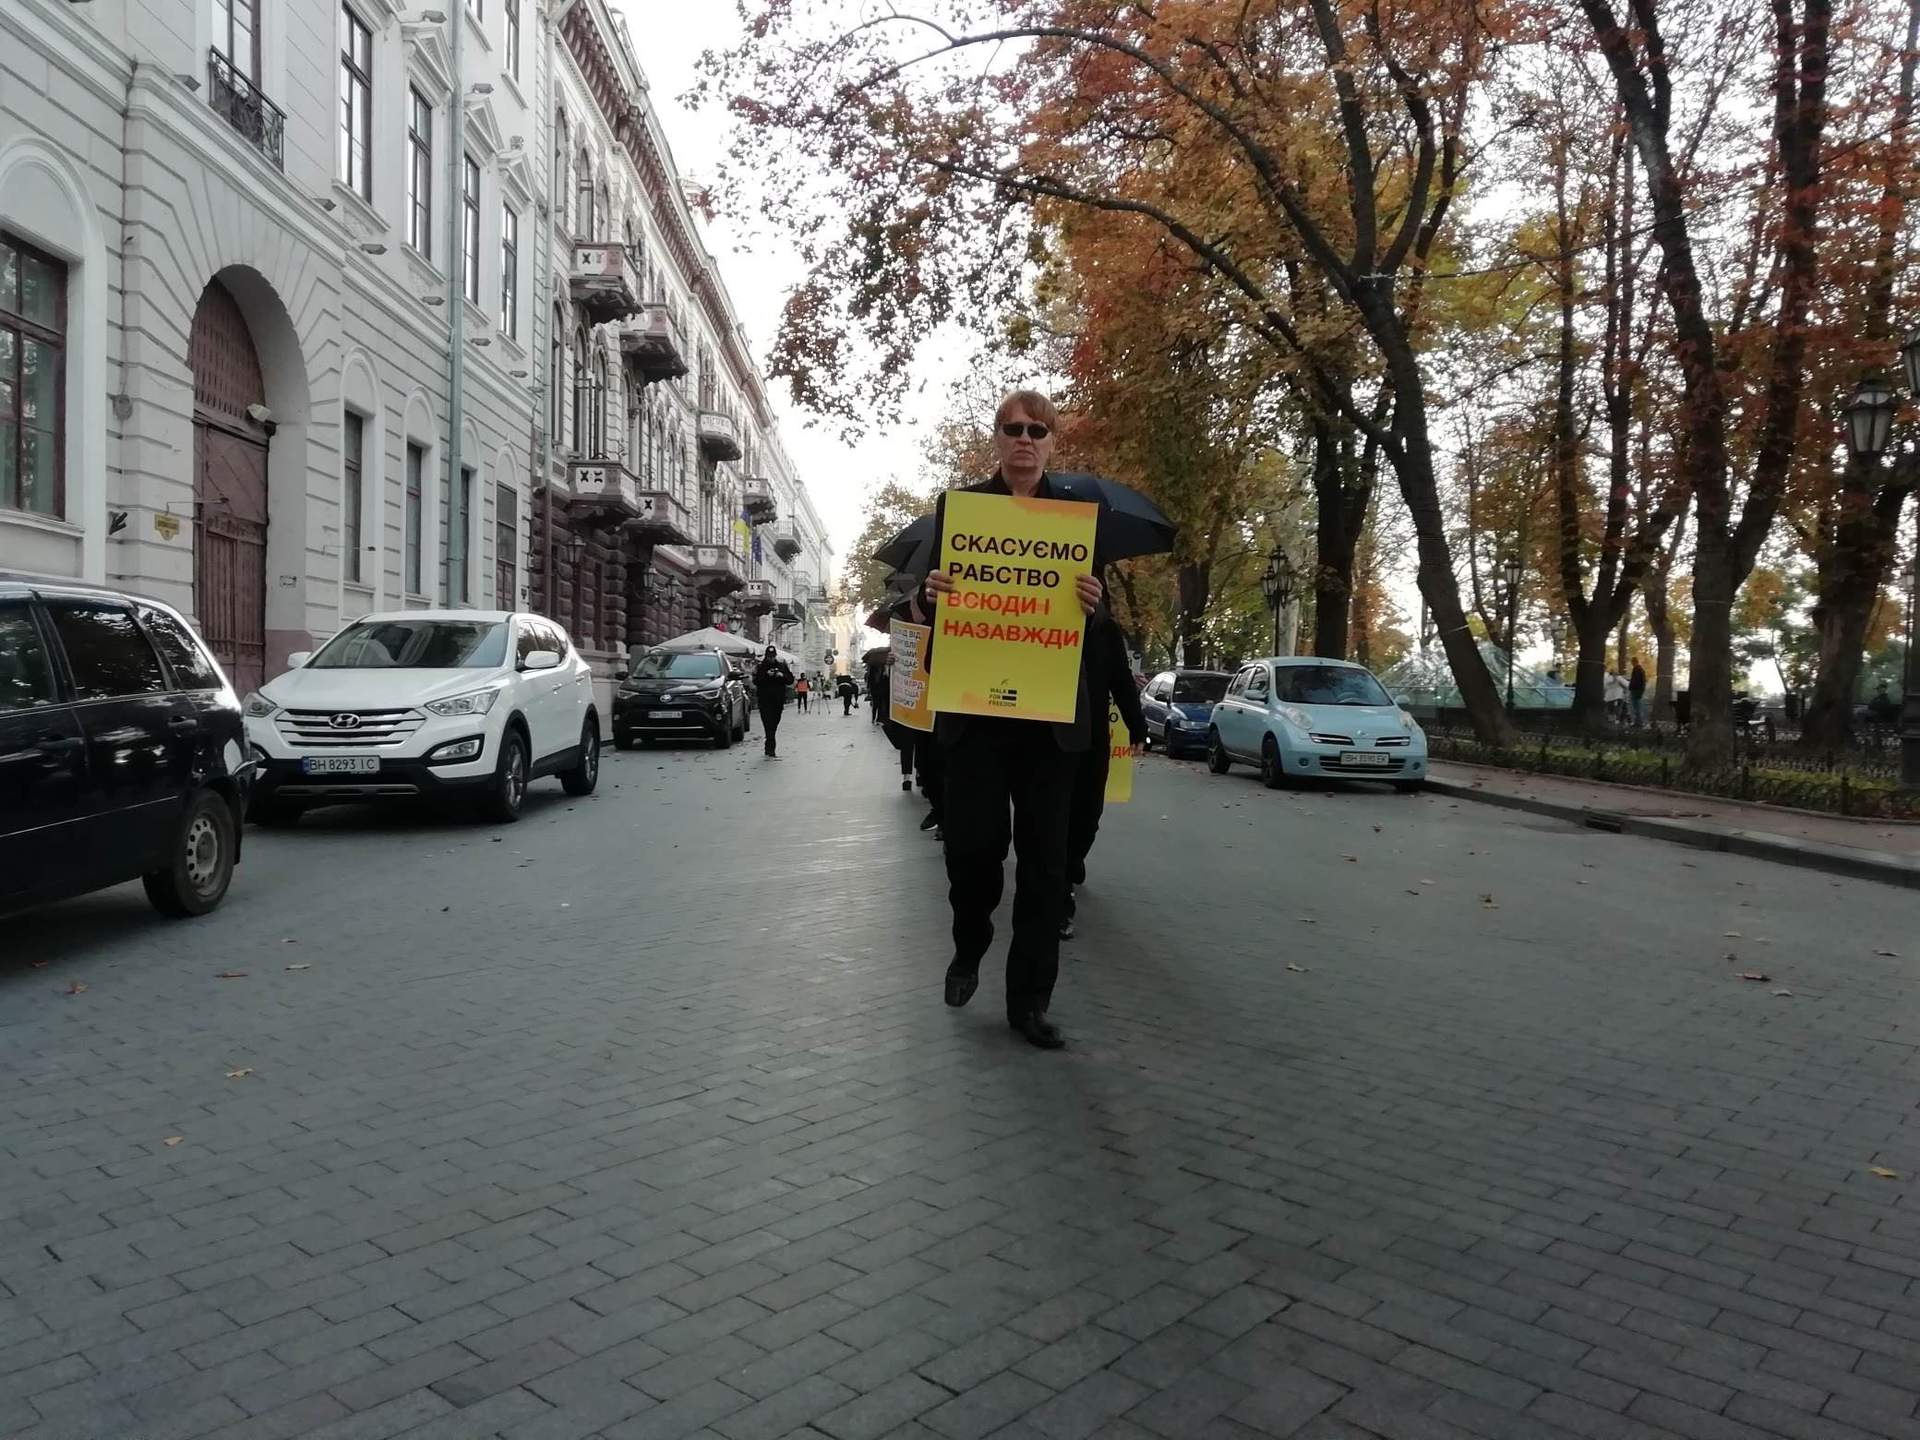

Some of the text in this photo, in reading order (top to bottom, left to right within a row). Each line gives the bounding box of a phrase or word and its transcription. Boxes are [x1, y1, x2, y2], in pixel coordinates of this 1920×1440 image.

[951, 533, 1088, 562] СКАСУЄМО
[949, 562, 1060, 588] РАБСТВО
[947, 591, 1037, 617] ВСЮДИ
[943, 619, 1080, 649] НАЗАВЖДИ
[309, 759, 327, 771] BH
[329, 758, 357, 770] 8293
